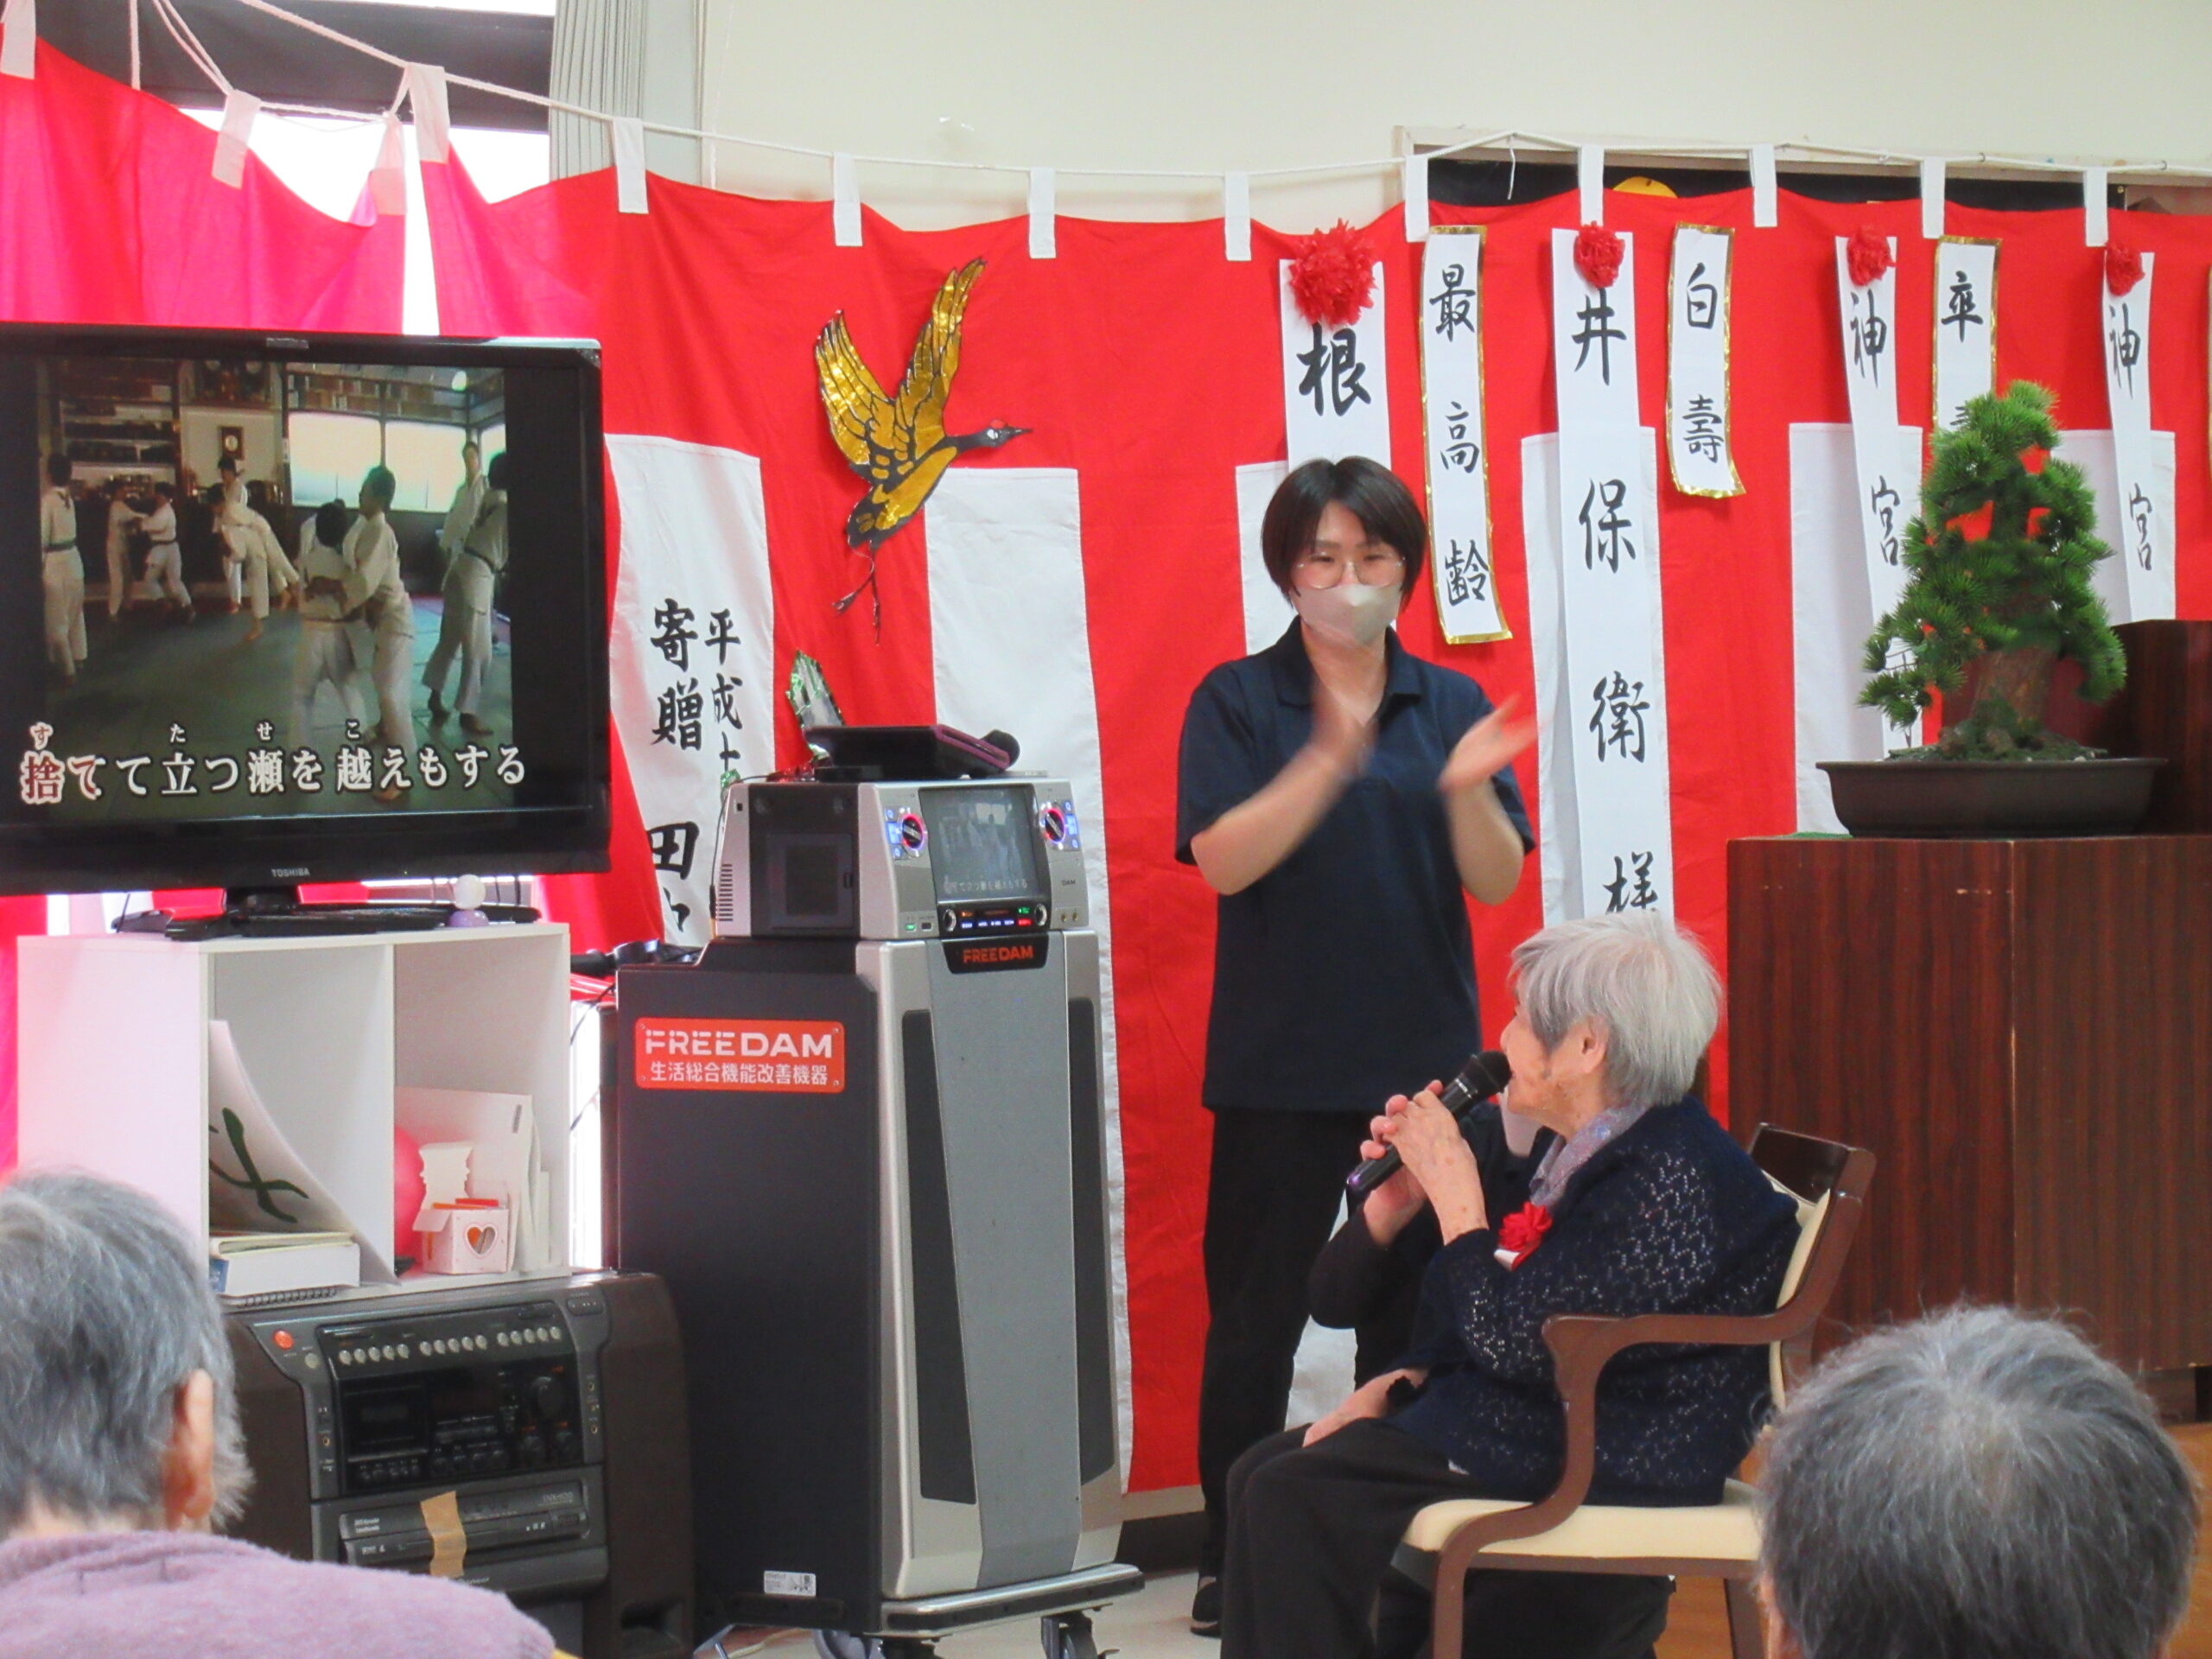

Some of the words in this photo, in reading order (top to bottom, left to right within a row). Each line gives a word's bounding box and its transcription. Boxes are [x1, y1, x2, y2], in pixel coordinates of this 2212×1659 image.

[1298, 322, 1372, 416] 根
[1429, 264, 1489, 606] 最高齢
[650, 598, 704, 751] 寄贈
[29, 722, 54, 747] す
[170, 723, 187, 744] た
[257, 722, 274, 742] せ
[346, 721, 360, 739] こ
[271, 868, 310, 877] TOSHIBA
[963, 945, 1034, 964] FREEDAM
[645, 1030, 834, 1058] FREEDAM
[650, 1061, 829, 1086] 生活総合機能改善機器
